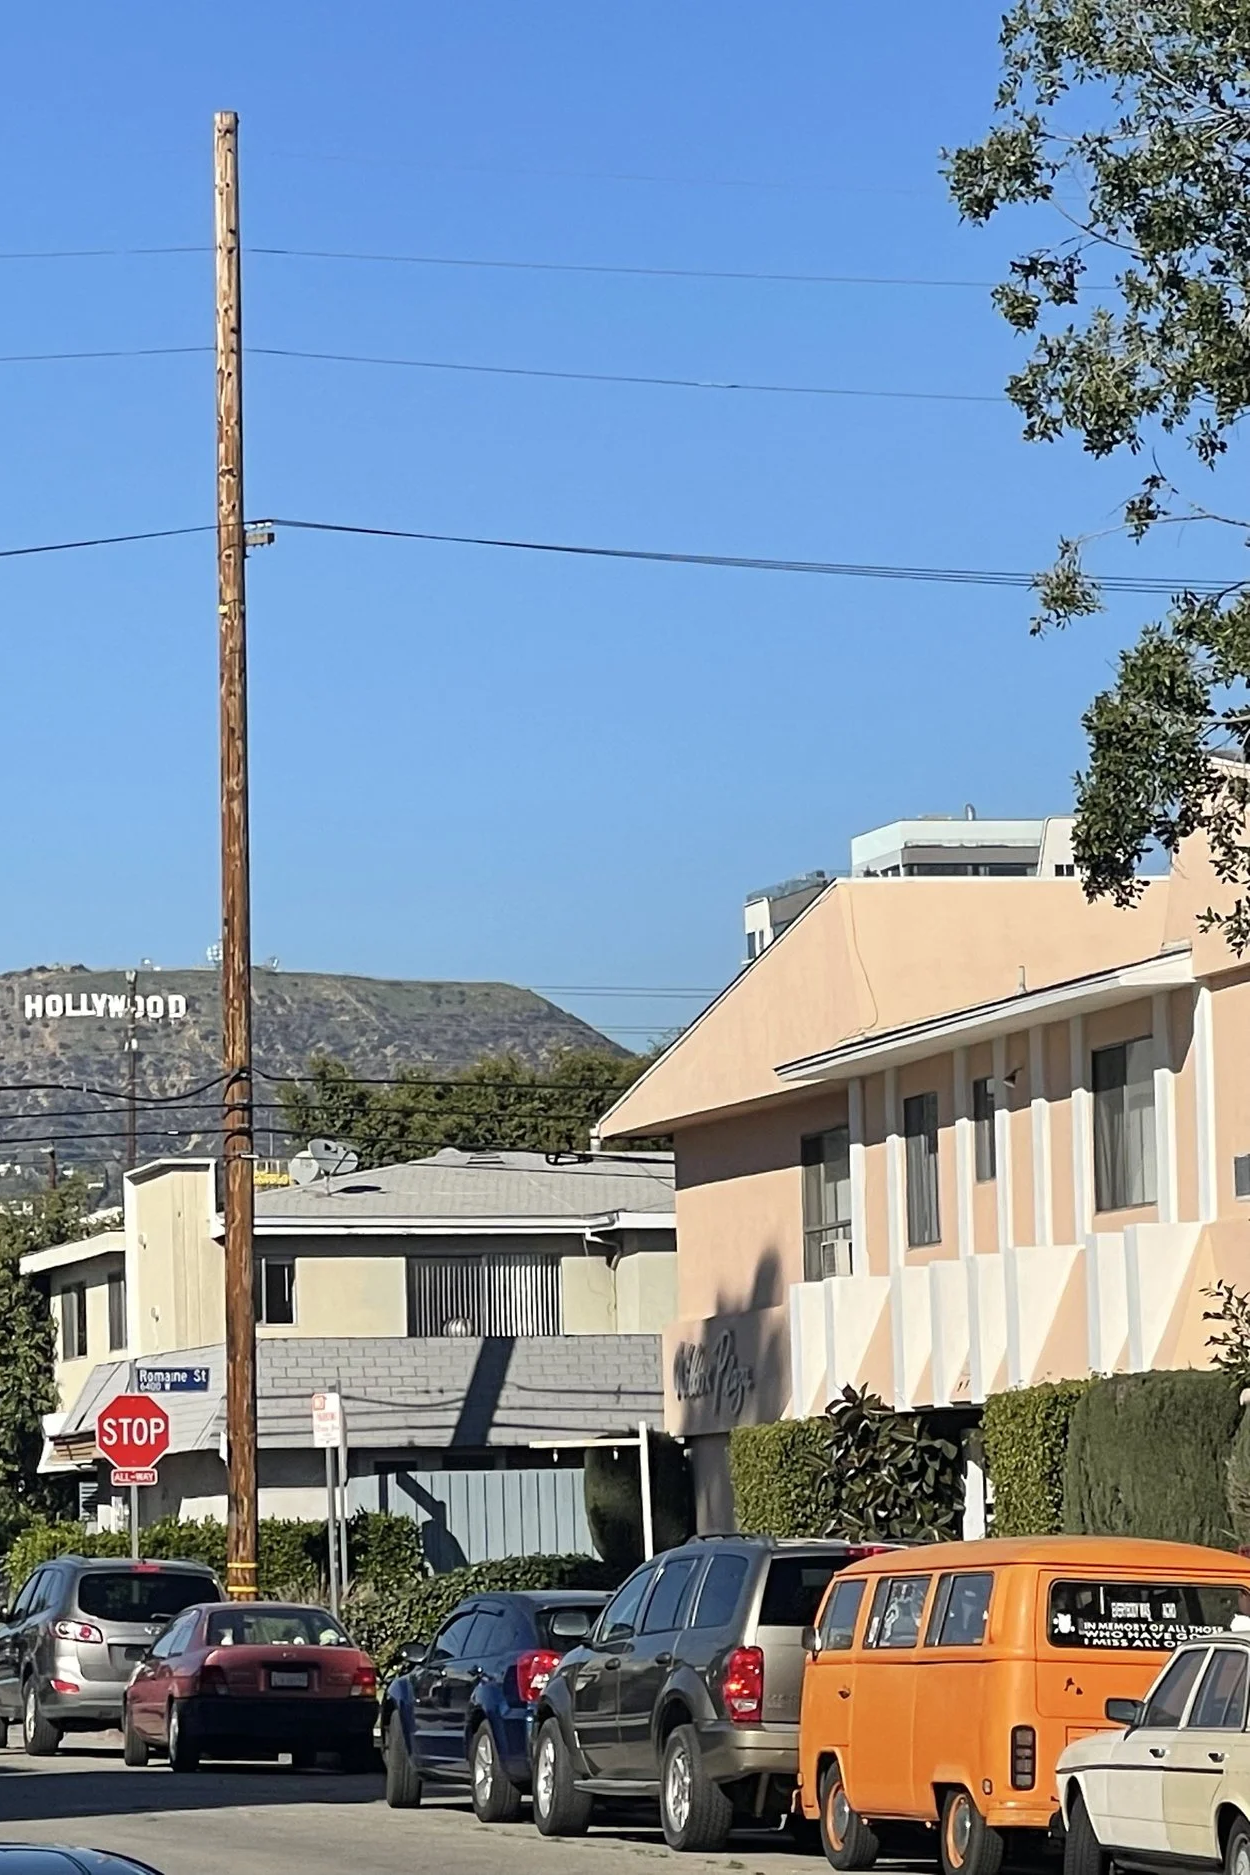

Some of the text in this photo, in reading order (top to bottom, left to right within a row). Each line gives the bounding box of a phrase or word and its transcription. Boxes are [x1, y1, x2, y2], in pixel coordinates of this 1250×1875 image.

[24, 993, 187, 1019] HOLLYWOOD
[139, 1369, 207, 1382] Romaine St
[102, 1418, 165, 1446] STOP
[114, 1473, 154, 1481] ALL-WAY
[1084, 1622, 1096, 1630] IN
[1098, 1622, 1147, 1632] MEMORY
[1150, 1624, 1164, 1632] OF
[1168, 1625, 1186, 1633] ALL
[1128, 1631, 1172, 1640] HAVE
[1092, 1639, 1129, 1647] MISS
[1132, 1639, 1160, 1648] ALL
